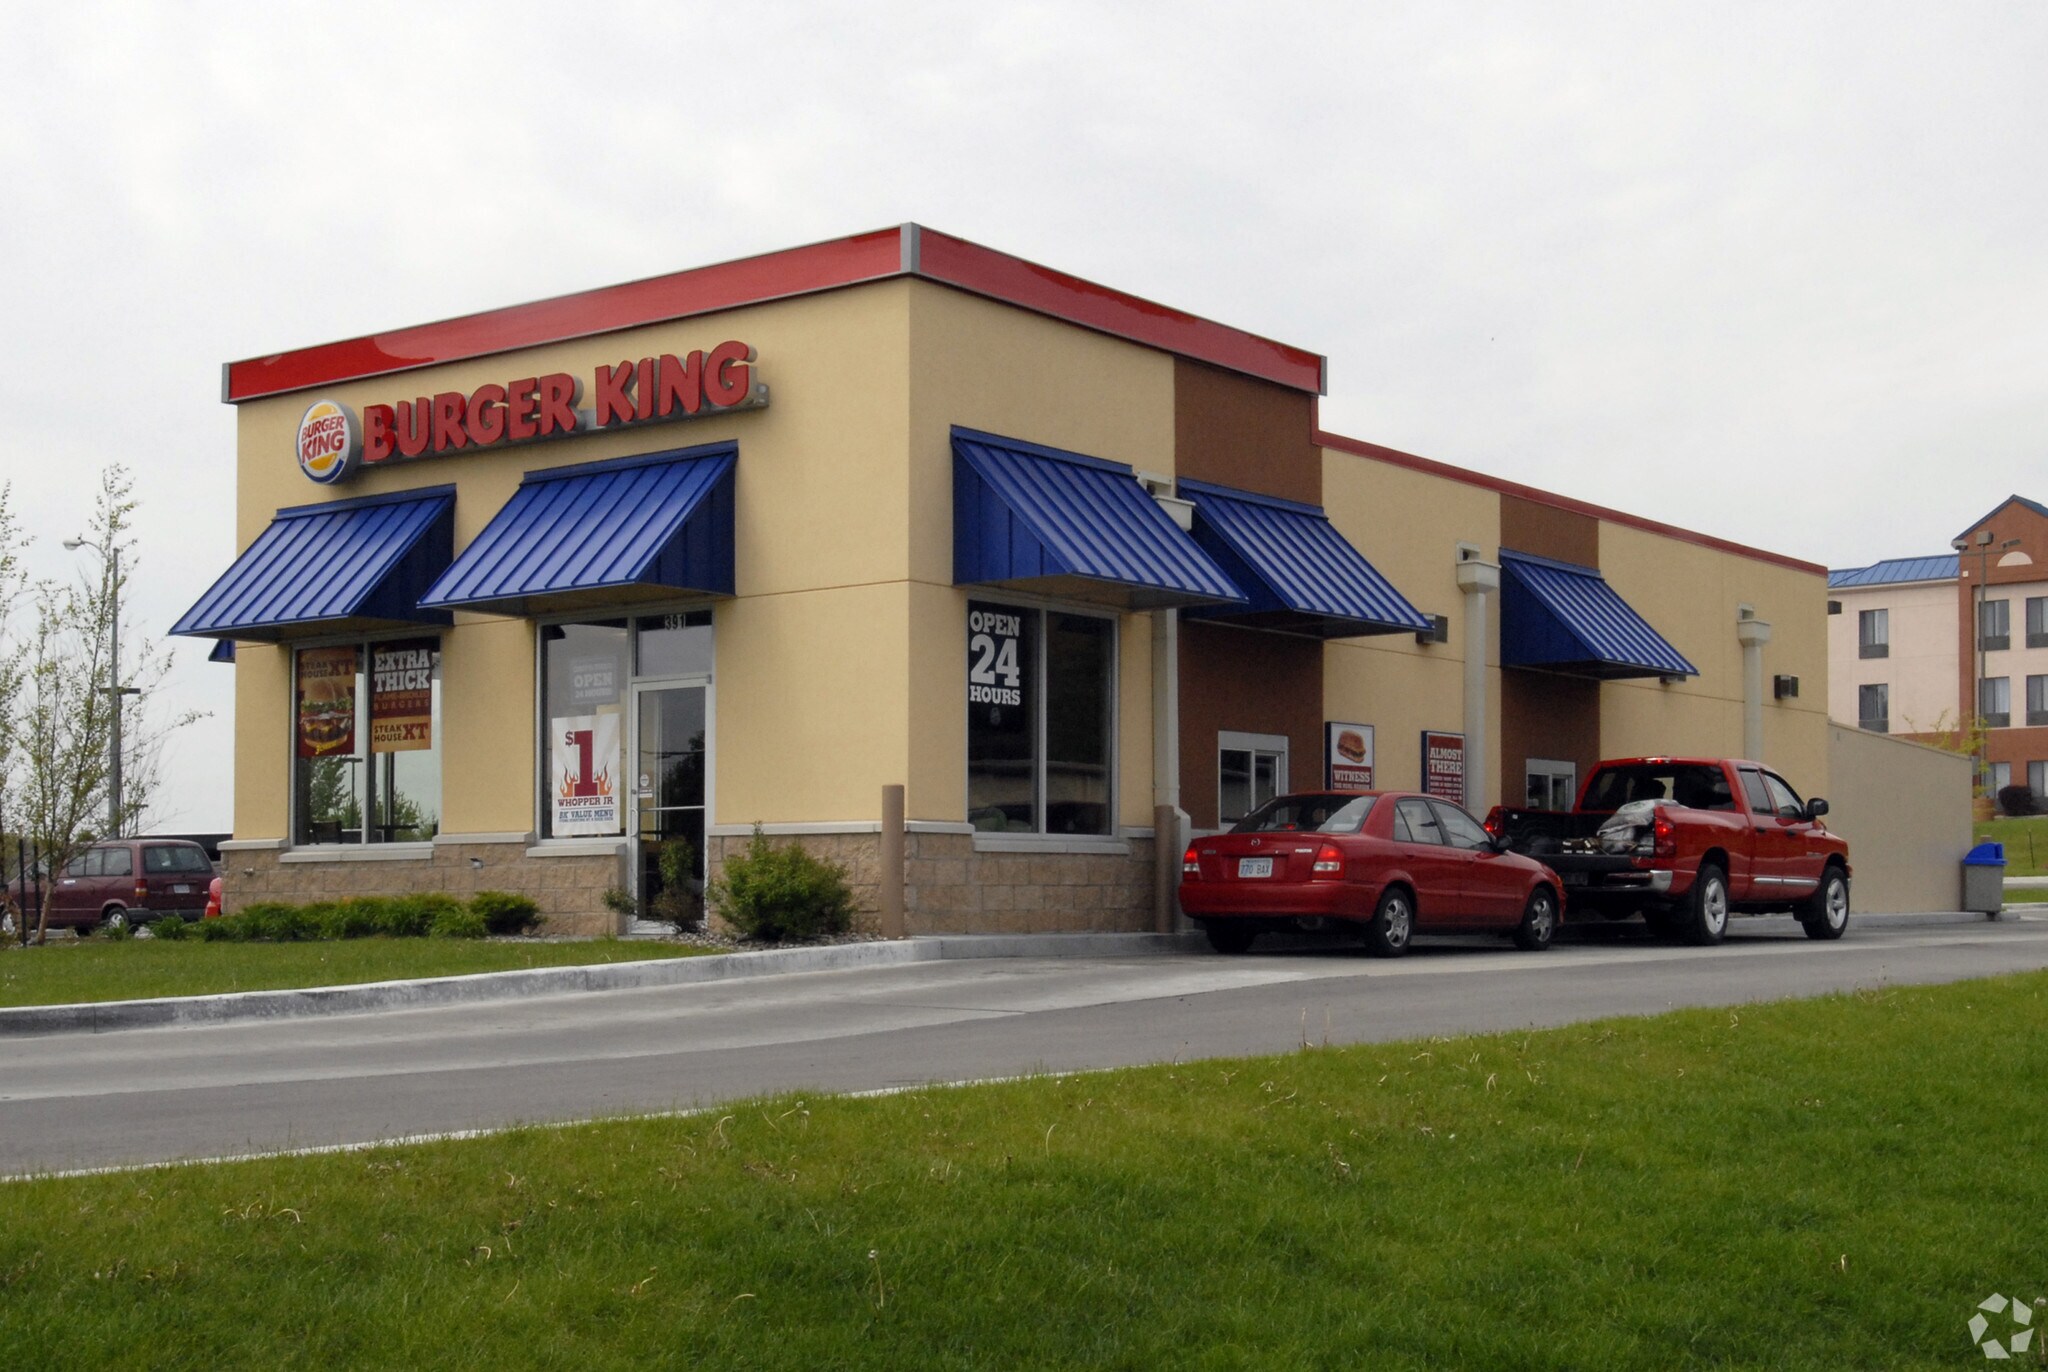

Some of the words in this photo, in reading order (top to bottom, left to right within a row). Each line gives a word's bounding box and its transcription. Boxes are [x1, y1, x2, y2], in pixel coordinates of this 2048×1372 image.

[363, 372, 580, 462] BURGER
[596, 340, 754, 427] KING
[301, 415, 345, 442] BURGER
[301, 430, 345, 464] KING
[969, 610, 1021, 637] OPEN
[374, 649, 430, 672] EXTRA
[970, 633, 1020, 687] 24
[374, 668, 430, 693] THICK
[574, 672, 613, 688] OPEN
[969, 685, 1021, 706] HOURS
[374, 724, 402, 734] STEAK
[374, 732, 402, 742] HOUSE
[402, 722, 429, 740] XT
[1429, 747, 1463, 761] ALMOST
[1333, 769, 1371, 783] WITNESS
[1429, 759, 1463, 775] THERE
[558, 797, 601, 807] WHOPPER
[570, 810, 593, 818] VALUE
[594, 809, 614, 818] MENU
